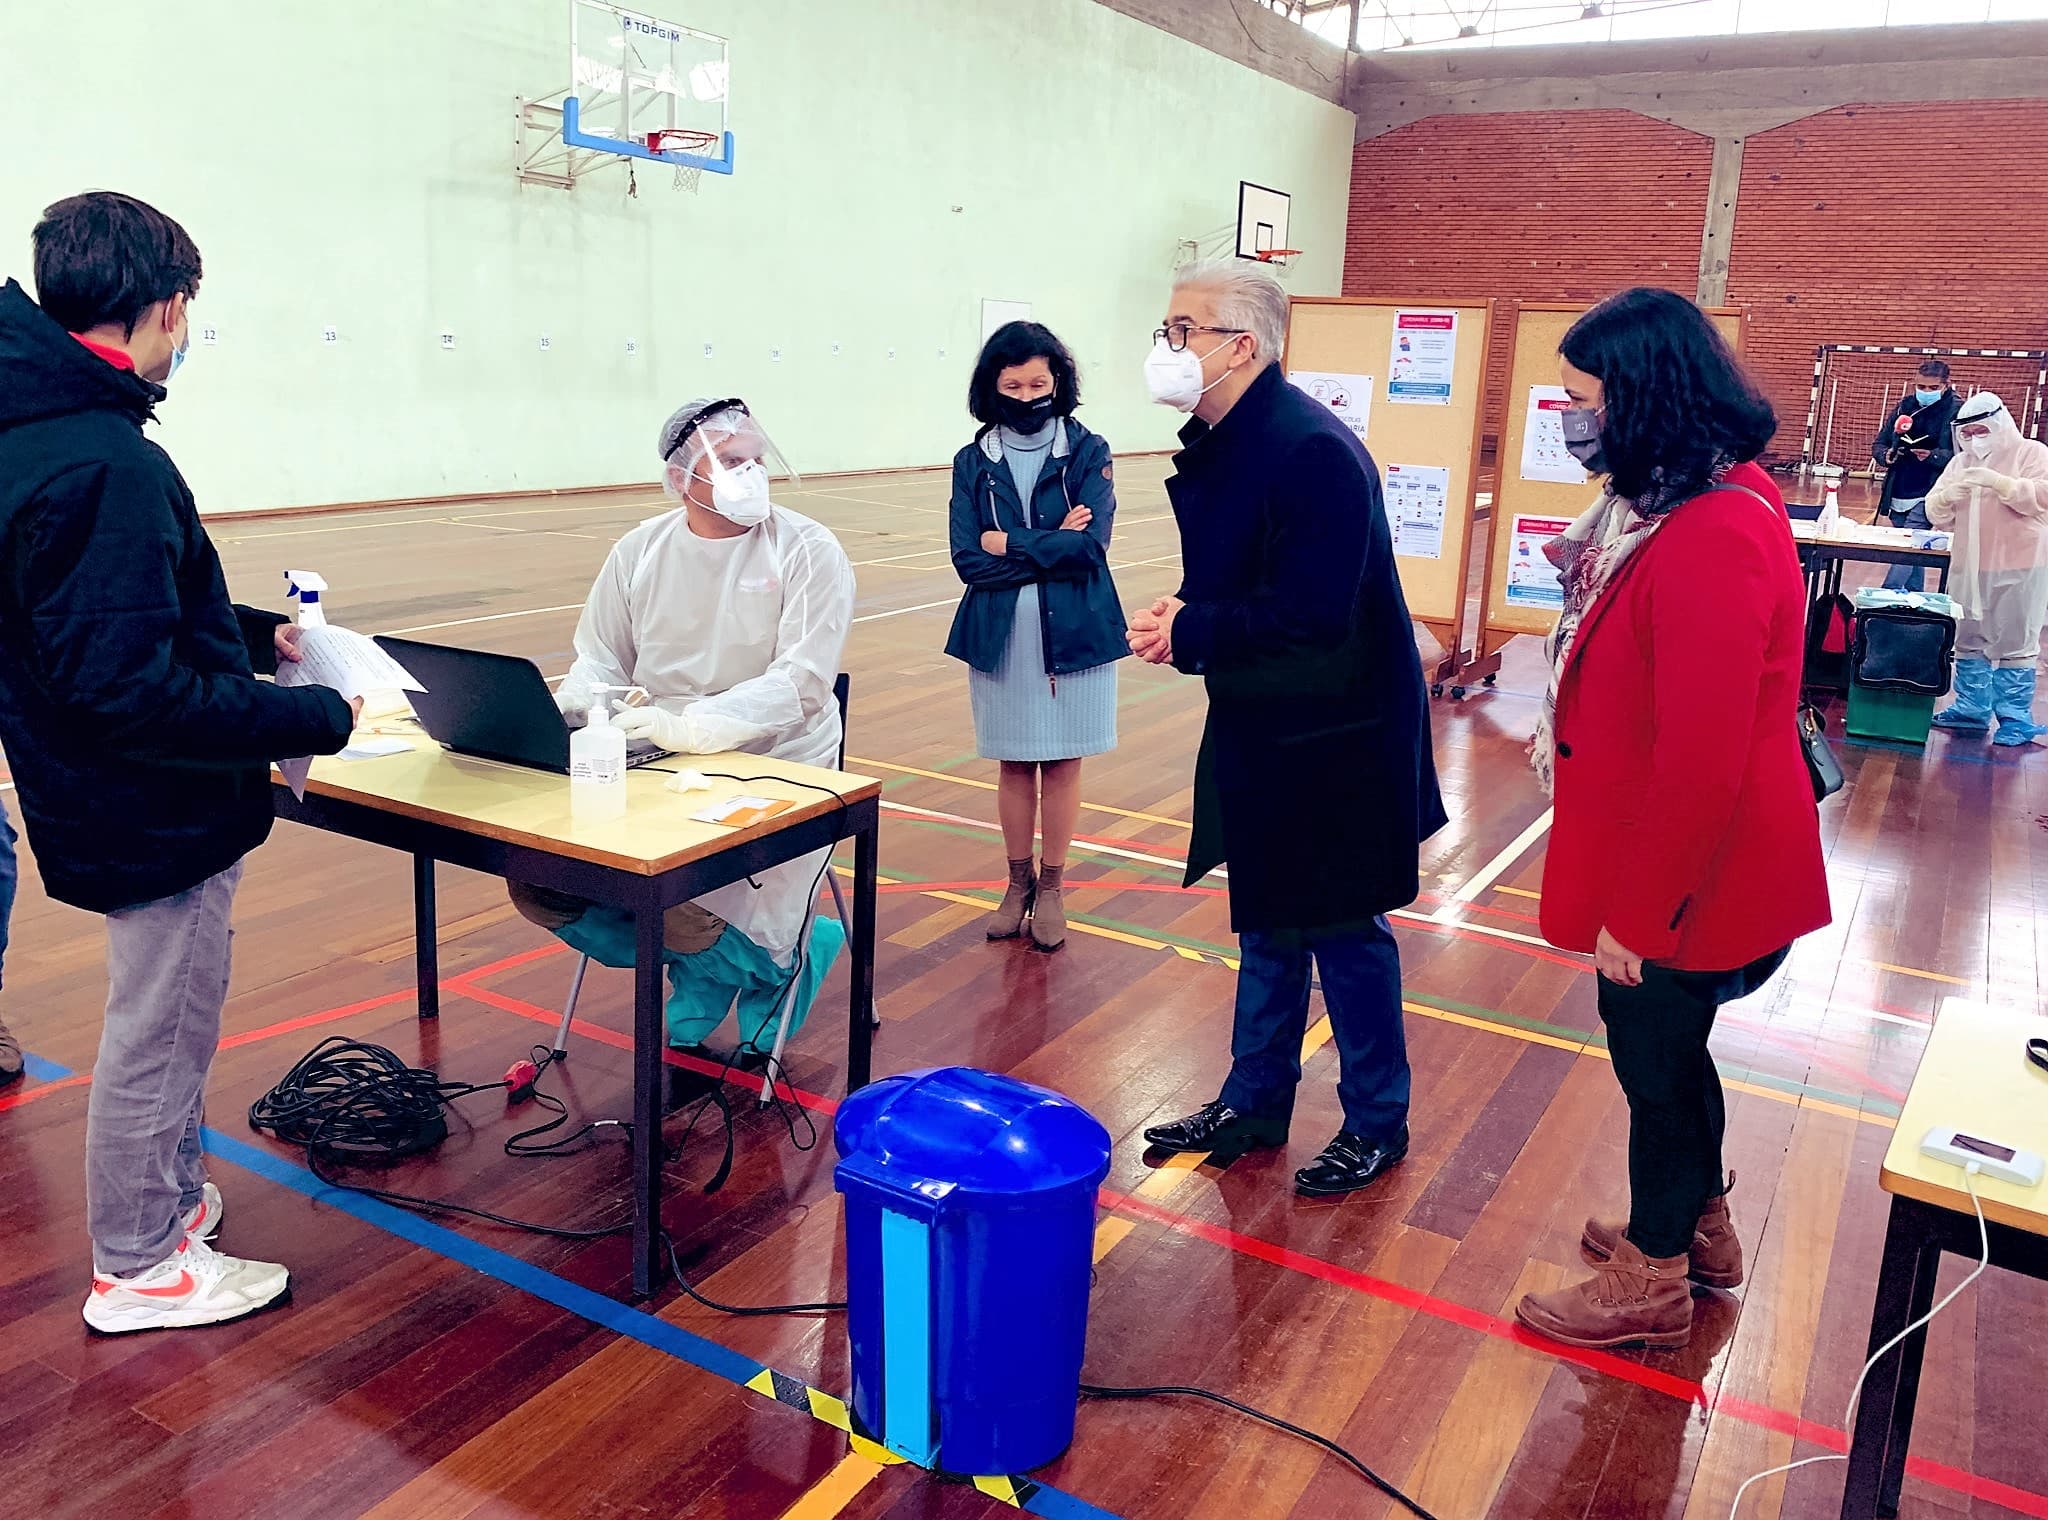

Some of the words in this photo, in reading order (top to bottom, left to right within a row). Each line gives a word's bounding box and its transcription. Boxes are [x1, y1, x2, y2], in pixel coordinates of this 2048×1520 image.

[634, 21, 680, 42] TOPGIM
[204, 329, 216, 340] 12
[325, 331, 337, 341] 13
[442, 334, 453, 344] 14
[541, 337, 550, 346] 15
[627, 342, 636, 351] 16
